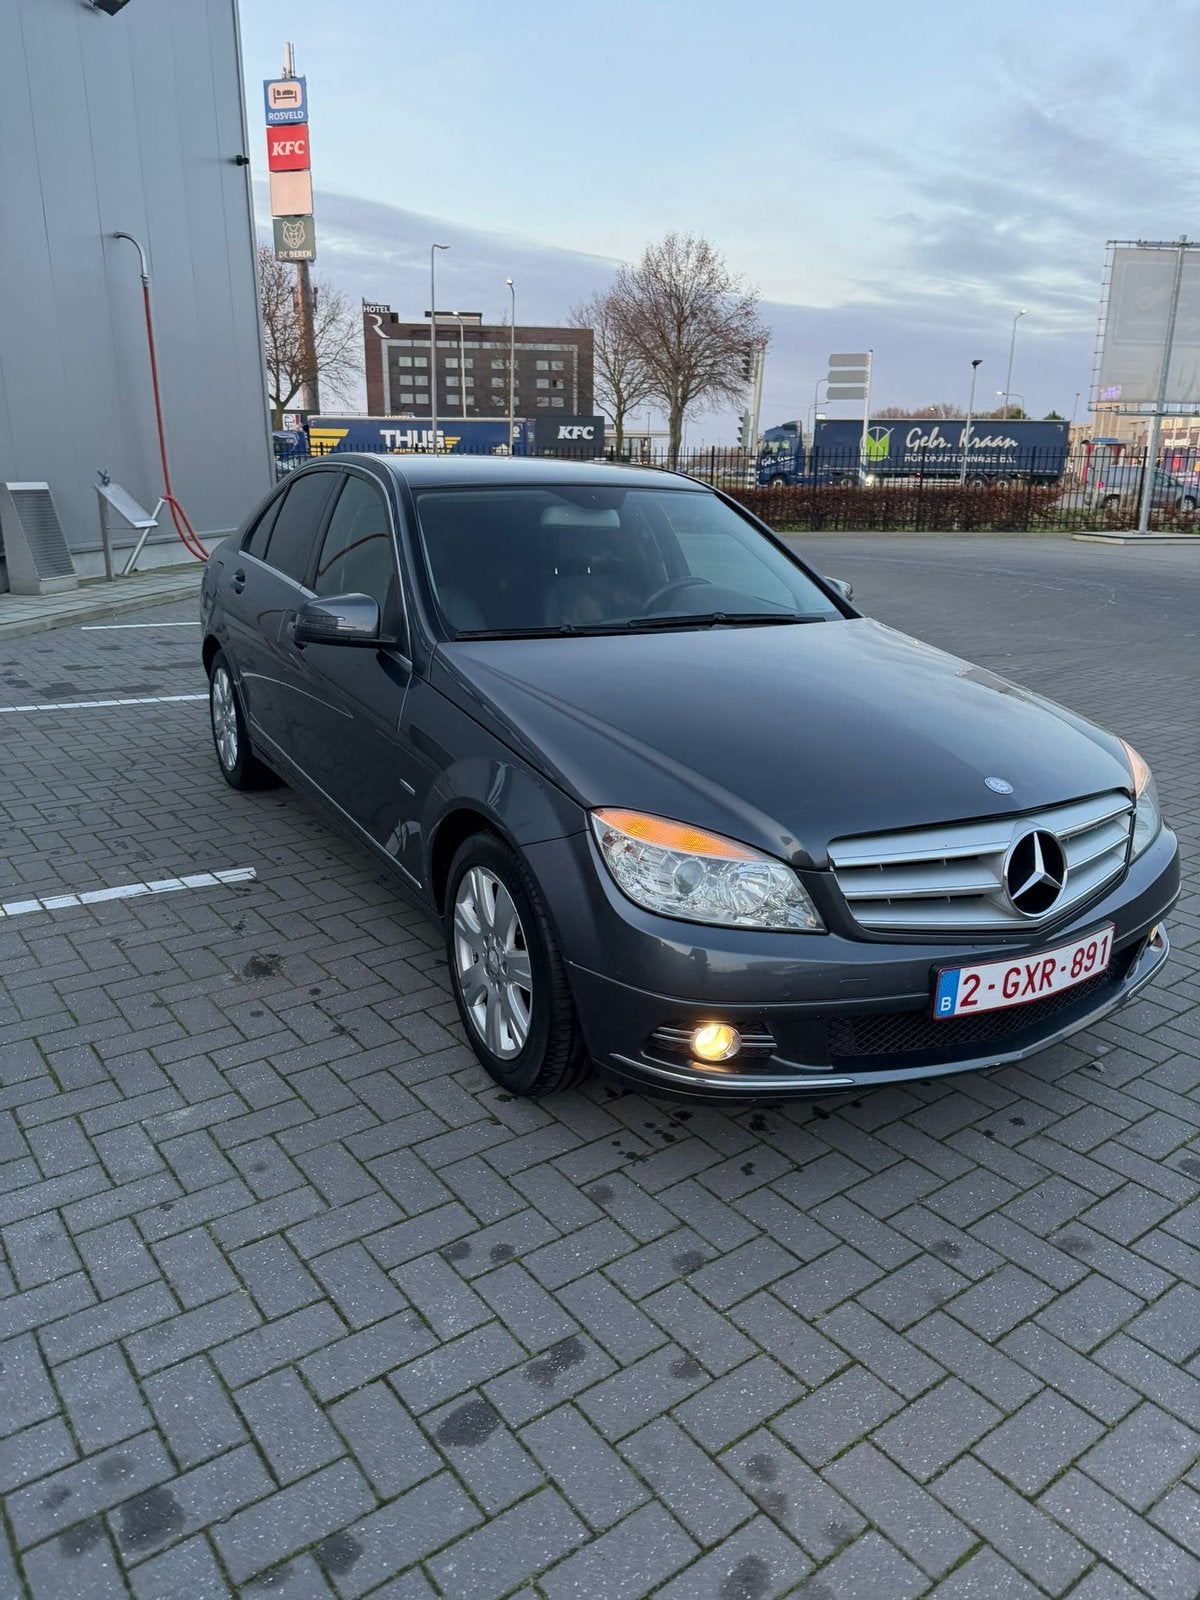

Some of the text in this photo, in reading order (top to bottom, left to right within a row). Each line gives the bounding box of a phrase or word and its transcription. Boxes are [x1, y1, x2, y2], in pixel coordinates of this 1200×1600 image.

[268, 110, 304, 121] ROSVELD
[271, 140, 305, 156] KFC
[289, 249, 312, 258] BEREN
[363, 305, 390, 314] HOTEL
[557, 425, 595, 440] KFC
[905, 426, 1019, 452] Gebr. Kraan
[940, 935, 1109, 1012] B 2-GXR-891
